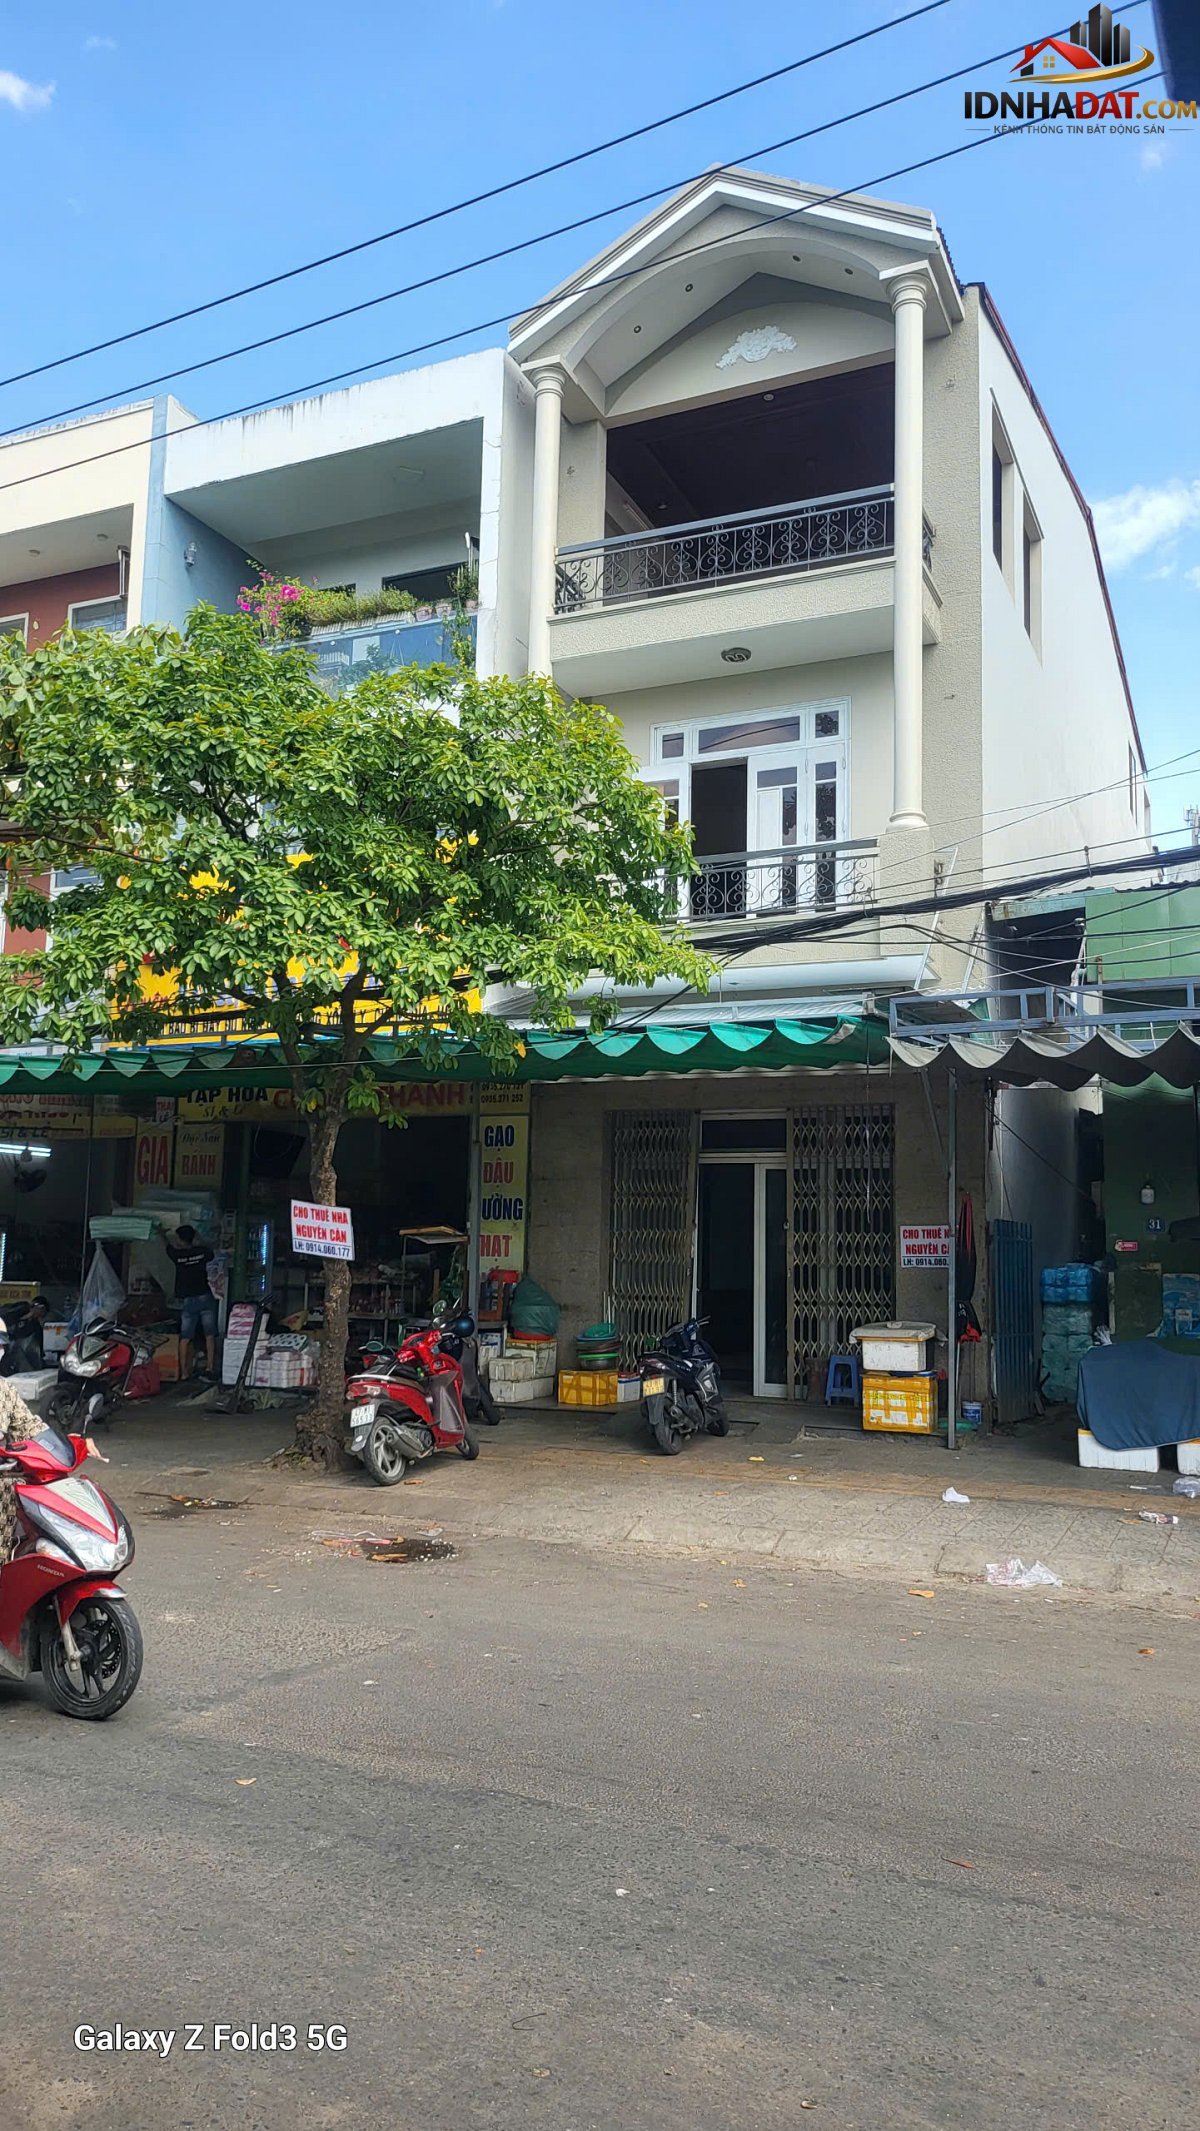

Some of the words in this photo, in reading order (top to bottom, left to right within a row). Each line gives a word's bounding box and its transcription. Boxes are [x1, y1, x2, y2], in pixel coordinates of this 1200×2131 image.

[484, 1125, 515, 1152] GẠO
[181, 1149, 216, 1175] BÁNH
[293, 1205, 308, 1219] CHO
[310, 1208, 329, 1222] THUÊ
[481, 1192, 523, 1220] ƯỜNG
[296, 1223, 327, 1240] NGUYÊN
[902, 1229, 919, 1239] CHO
[921, 1227, 942, 1239] THUÊ
[1148, 1219, 1161, 1230] 31
[294, 1241, 304, 1250] LH:
[305, 1242, 350, 1258] 0914.060.177
[905, 1242, 939, 1255] NGUYÊN
[903, 1258, 914, 1266] LH:
[915, 1258, 949, 1266] 0914.060.
[37, 1564, 65, 1578] HONDA
